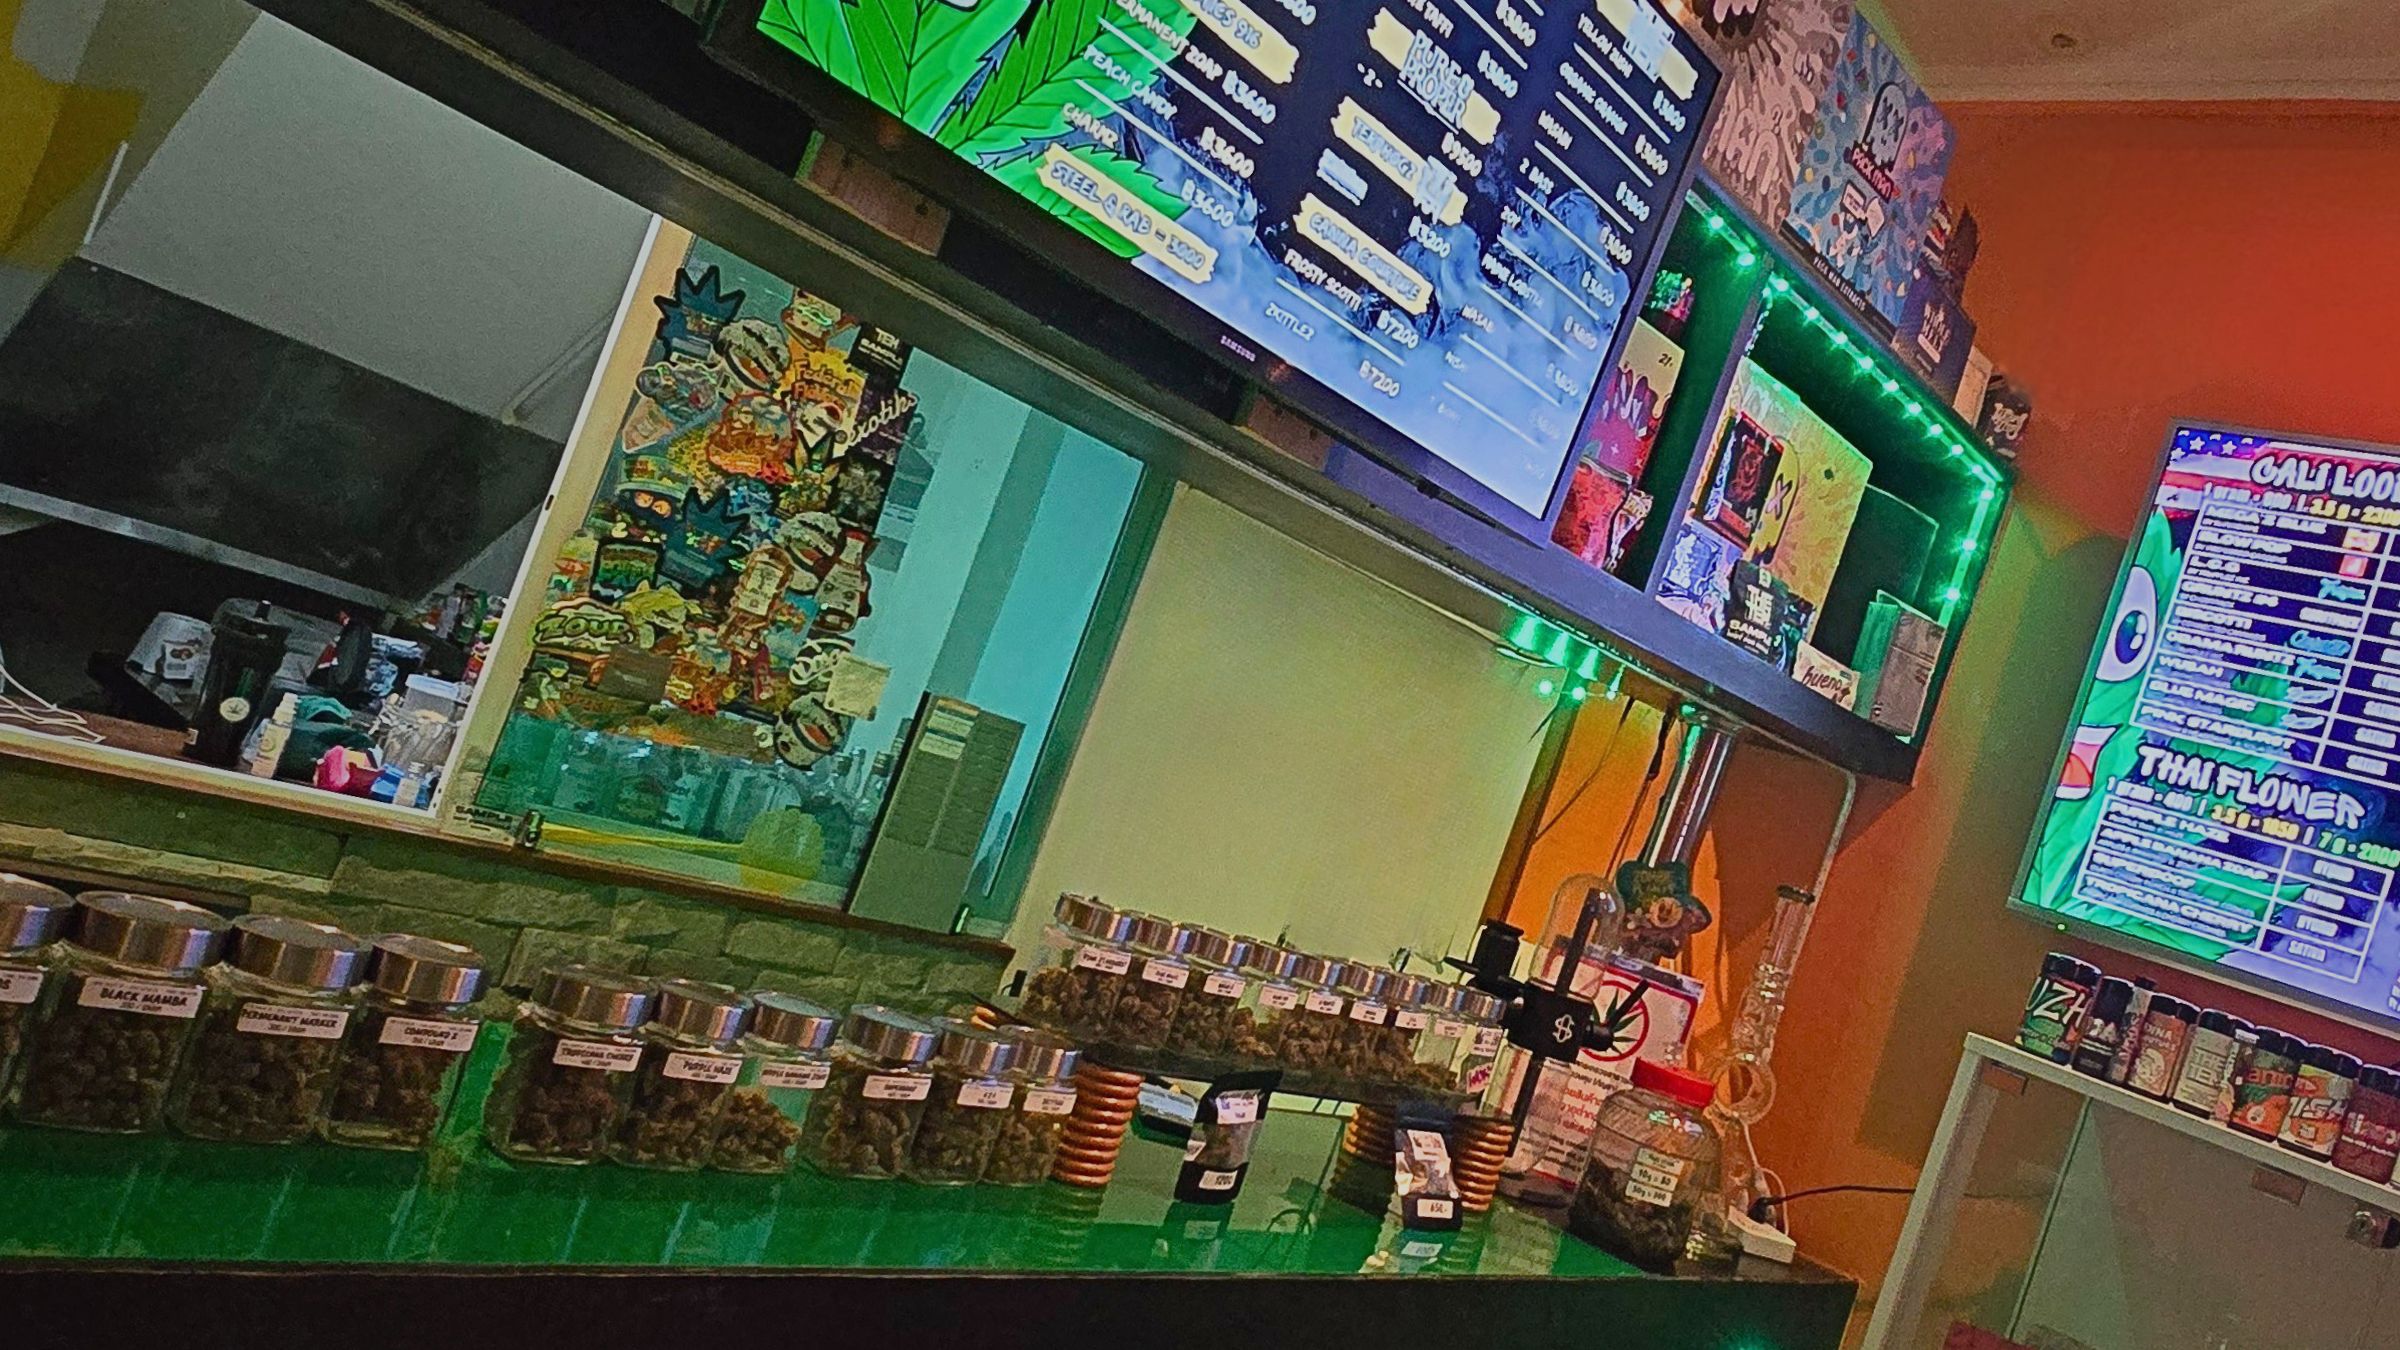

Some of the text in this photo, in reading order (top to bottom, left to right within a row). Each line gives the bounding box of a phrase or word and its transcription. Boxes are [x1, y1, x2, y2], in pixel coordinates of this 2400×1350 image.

[1084, 44, 1132, 87] PEACH
[1283, 248, 1328, 289] FROSTY
[2251, 455, 2331, 491] CALI
[2138, 745, 2216, 791] THAI
[2215, 764, 2366, 830] FLOWER
[100, 987, 138, 1002] BLACK
